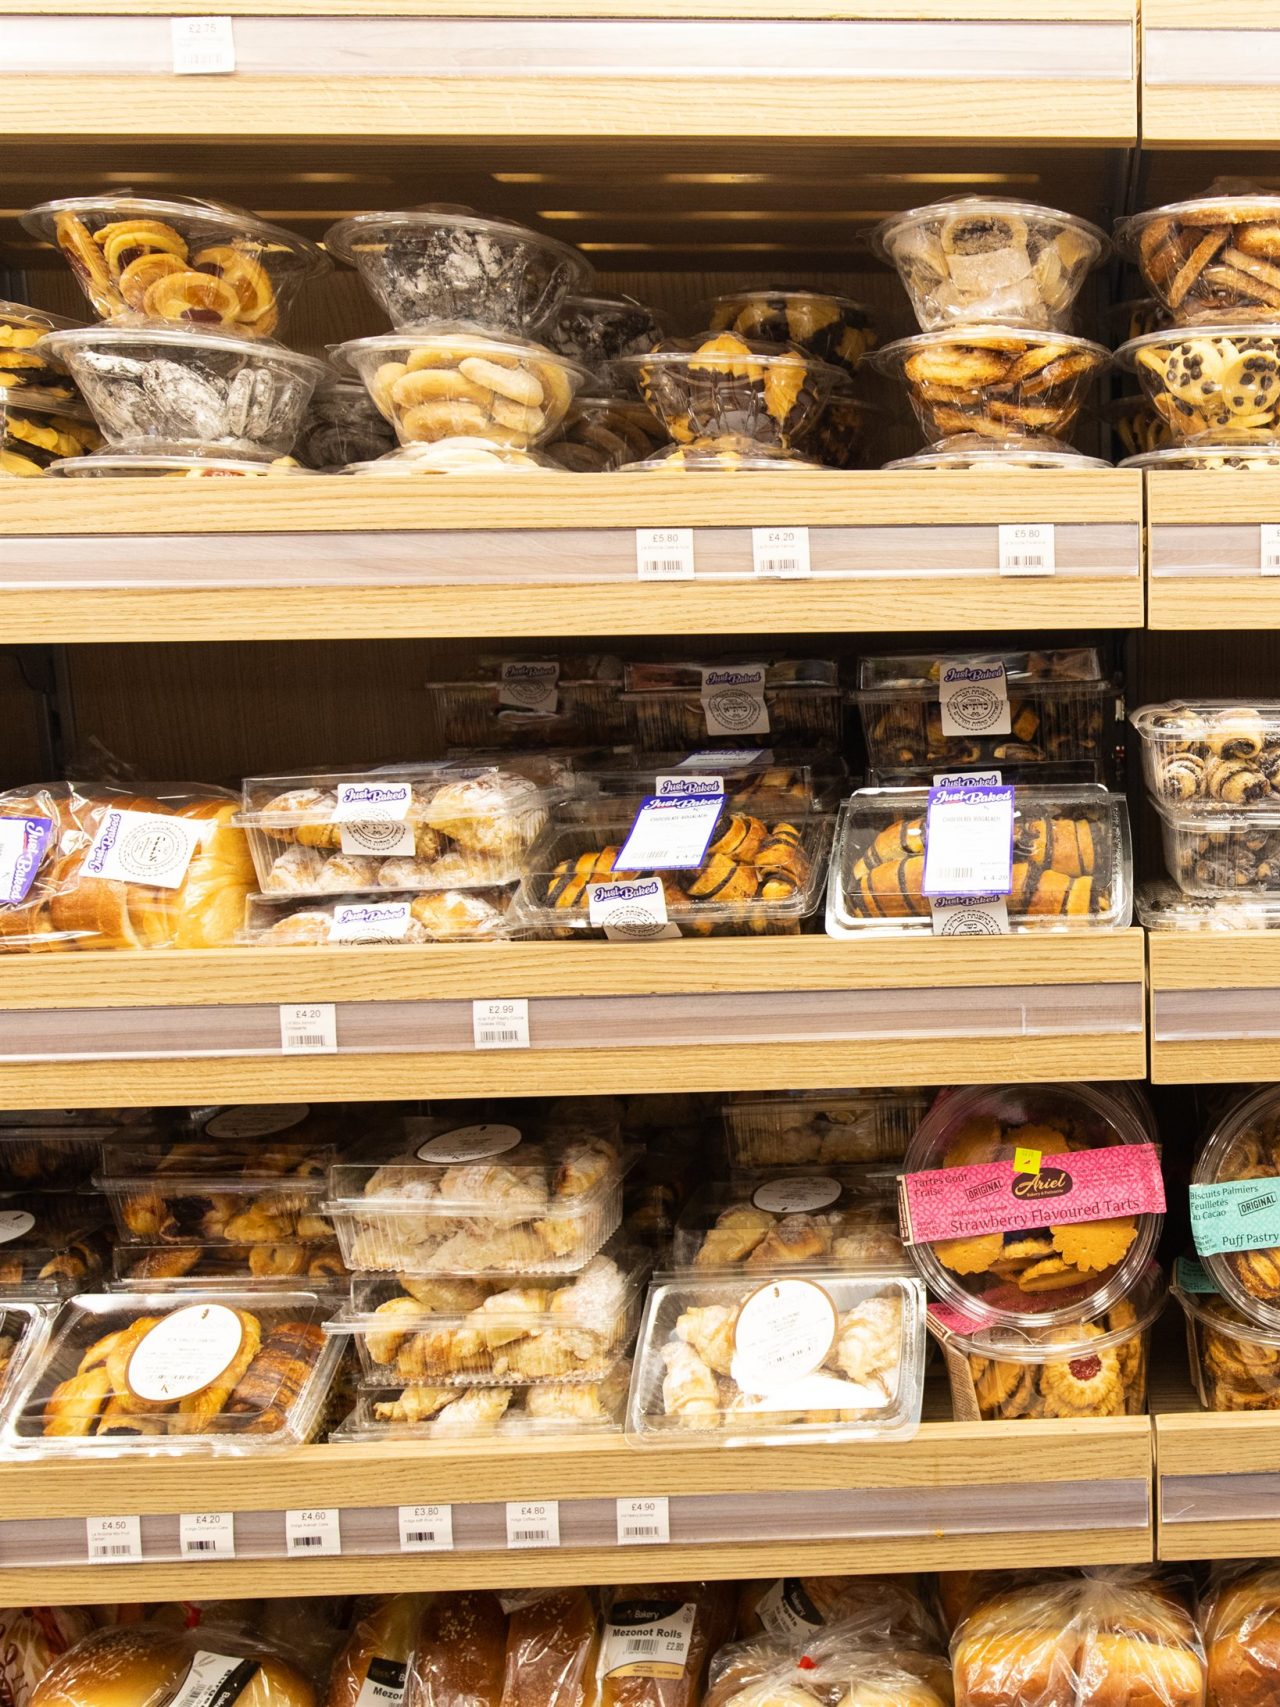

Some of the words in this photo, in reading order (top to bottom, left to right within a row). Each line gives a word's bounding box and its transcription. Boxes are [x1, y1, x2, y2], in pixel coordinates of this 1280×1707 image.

[653, 533, 679, 543] £5.80
[768, 532, 795, 542] £4.20
[1015, 529, 1040, 538] £5.80
[705, 672, 730, 685] Just
[728, 672, 762, 685] Baked
[944, 668, 970, 682] Just
[969, 665, 1003, 681] Baked
[660, 781, 686, 795] Just
[683, 780, 720, 794] Baked
[343, 788, 370, 803] Just
[368, 788, 407, 803] Baked
[932, 790, 964, 805] Just
[964, 789, 1012, 805] Baked
[644, 799, 677, 810] Just
[675, 796, 724, 809] Baked
[25, 821, 45, 858] Just
[88, 847, 106, 873] Just
[101, 813, 121, 849] Baked
[9, 852, 33, 904] Baked
[594, 887, 623, 902] Just
[620, 882, 659, 900] Baked
[935, 896, 962, 908] Just
[961, 895, 1000, 907] Baked
[338, 908, 367, 924] Just
[364, 907, 406, 923] Baked
[295, 1009, 321, 1019] £4.20
[488, 1005, 514, 1014] £2.99
[913, 1177, 944, 1188] Tartes
[1014, 1172, 1065, 1196] Ariel
[914, 1188, 944, 1198] Fraise
[968, 1180, 1004, 1199] ORIGINAL
[1222, 1185, 1259, 1196] Palmiers
[1190, 1198, 1229, 1210] Feuilletés
[1241, 1195, 1277, 1213] ORIGINAL
[950, 1214, 1028, 1233] Strawberry
[1031, 1202, 1100, 1222] Flavoured
[1103, 1198, 1140, 1213] Tarts
[1203, 1210, 1226, 1220] Cacao
[1222, 1233, 1245, 1247] Puff
[1246, 1231, 1279, 1244] Pastry
[414, 1507, 439, 1516] £3.80
[521, 1506, 545, 1515] £4.80
[631, 1502, 655, 1511] £4.90
[196, 1515, 220, 1524] £4.20
[301, 1511, 326, 1520] £4.60
[102, 1521, 126, 1530] £4.50
[634, 1610, 660, 1619] Bakery
[612, 1628, 654, 1638] Mezonot
[656, 1628, 682, 1639] Rolls
[666, 1642, 684, 1652] £2.80
